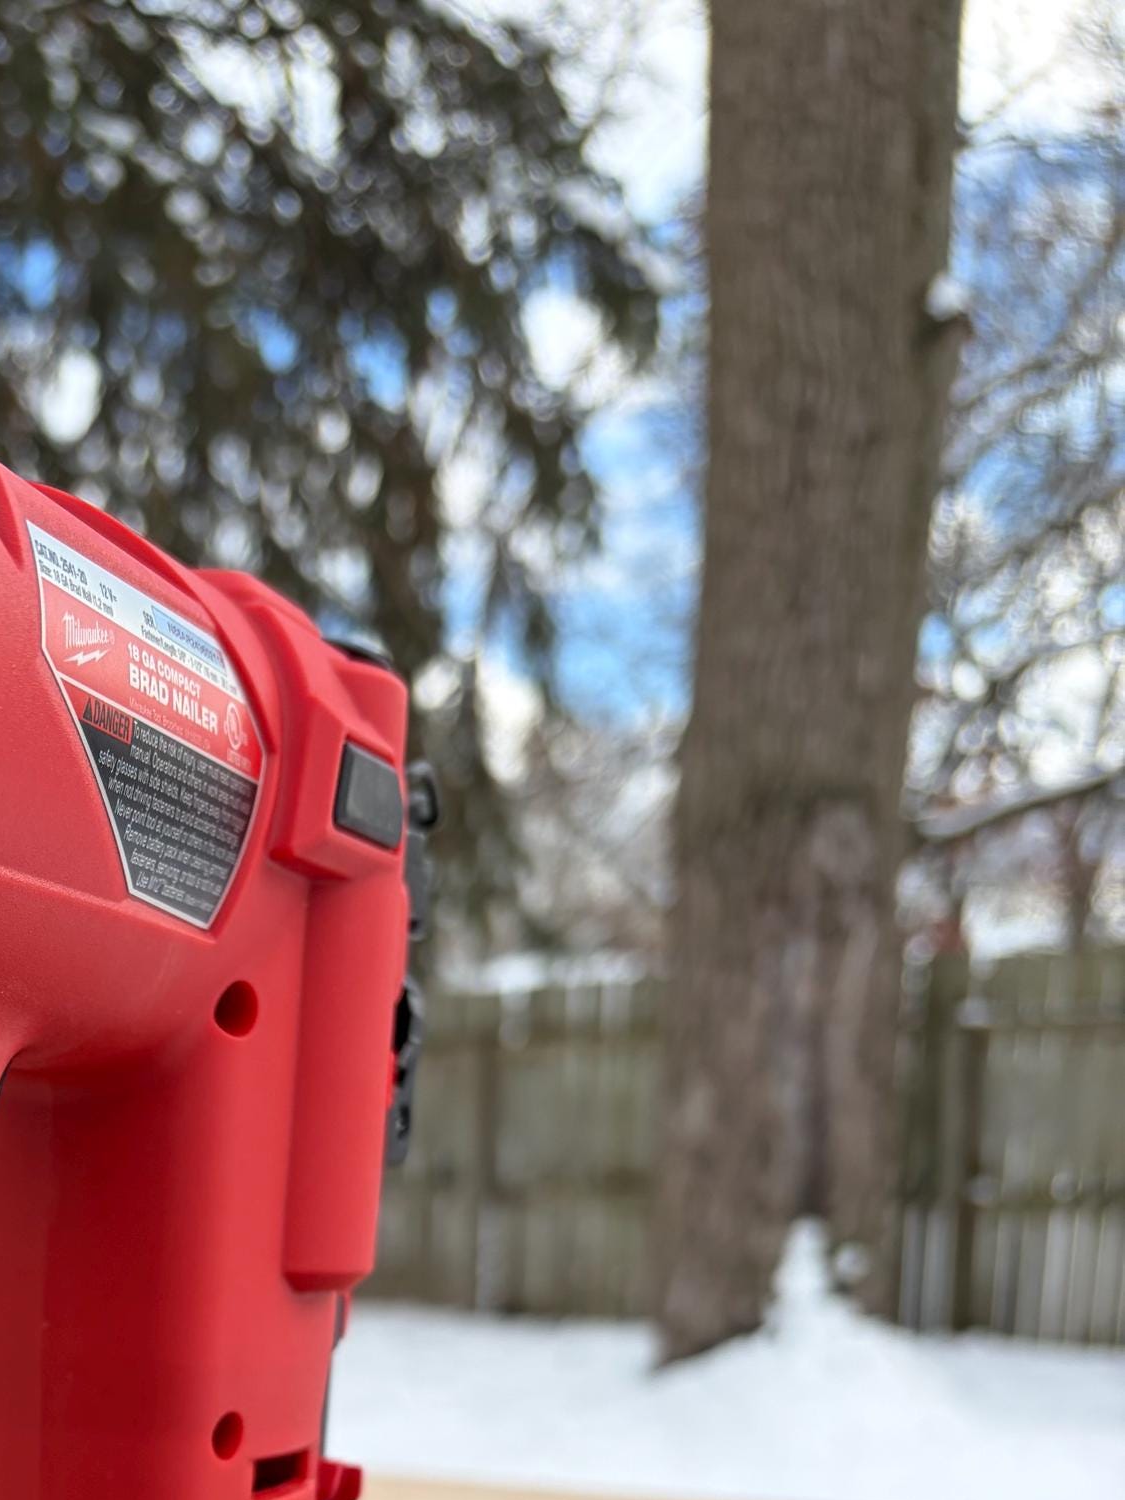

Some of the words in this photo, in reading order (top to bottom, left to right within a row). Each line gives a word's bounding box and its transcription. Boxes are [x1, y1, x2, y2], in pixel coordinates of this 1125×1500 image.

[62, 611, 110, 649] Milwaukee
[127, 641, 139, 662] 18
[141, 650, 156, 672] GA
[157, 659, 201, 699] COMPACT
[129, 663, 170, 706] BRAD
[172, 687, 218, 735] NAILER
[92, 700, 130, 742] DANGER
[140, 728, 159, 749] reduce
[98, 749, 115, 773] safety
[115, 757, 138, 780] glasses
[108, 776, 125, 795] when
[114, 798, 133, 820] Never
[124, 823, 147, 847] Remove
